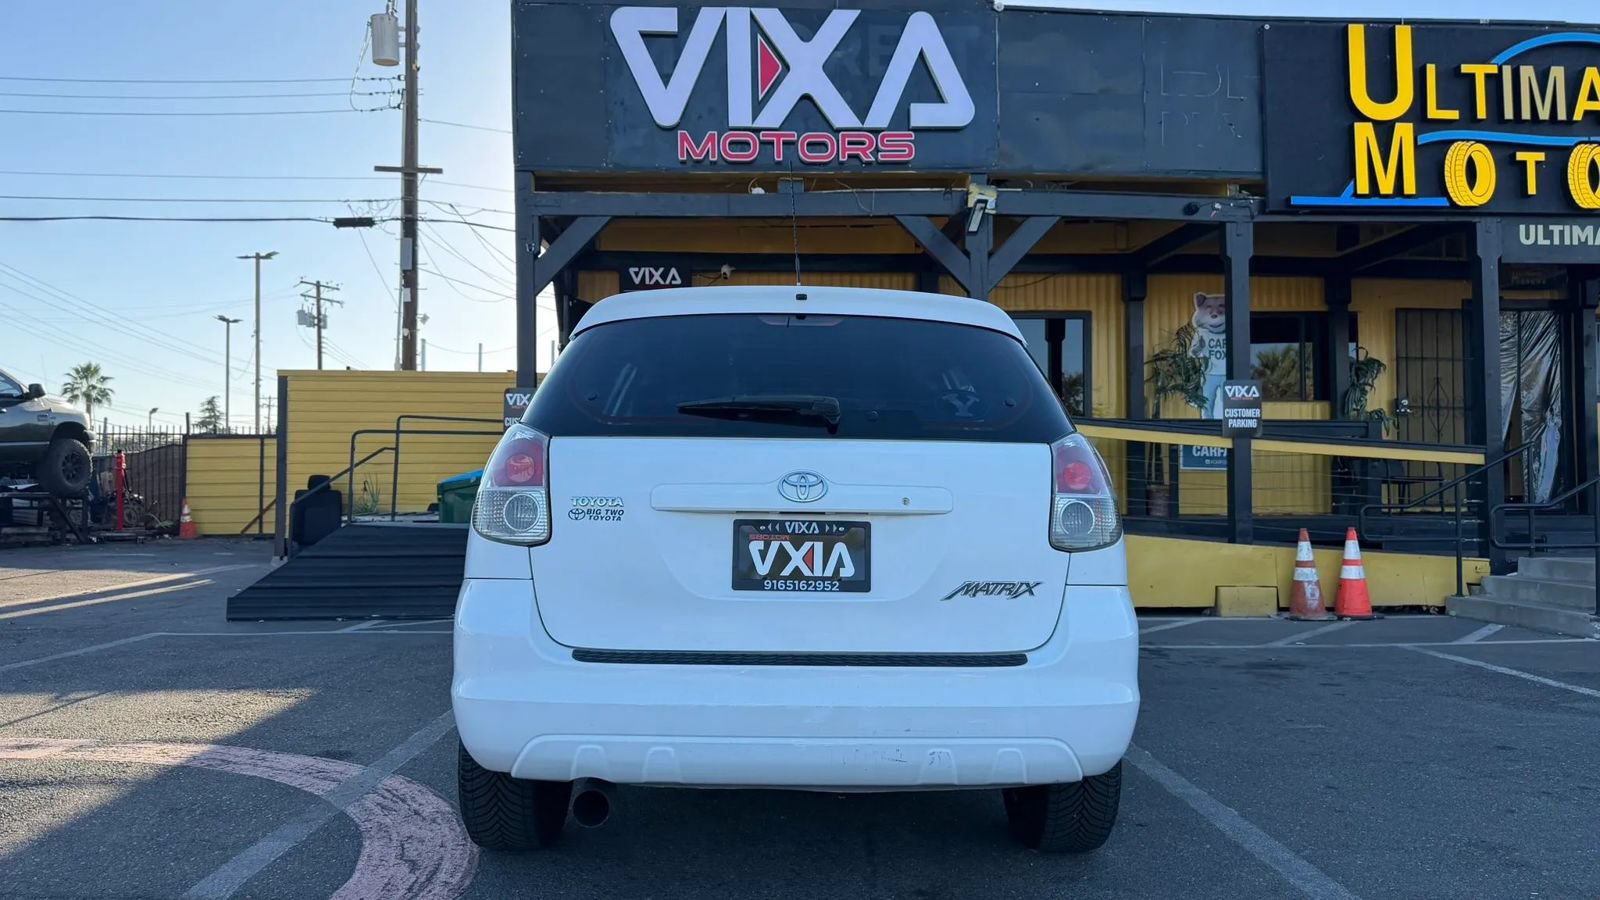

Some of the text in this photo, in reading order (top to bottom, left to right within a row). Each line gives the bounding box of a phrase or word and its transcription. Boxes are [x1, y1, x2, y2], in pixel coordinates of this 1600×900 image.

[609, 6, 976, 129] VIXA
[678, 130, 915, 163] MOTORS
[628, 267, 682, 285] VIXA
[1224, 385, 1260, 398] VIXA
[1224, 408, 1260, 418] CUSTOMER
[1228, 418, 1258, 428] PARKING
[570, 496, 624, 507] TOYOTA
[785, 522, 819, 533] VIXA
[764, 580, 840, 591] 9165162952
[940, 581, 1043, 601] MATRIX
